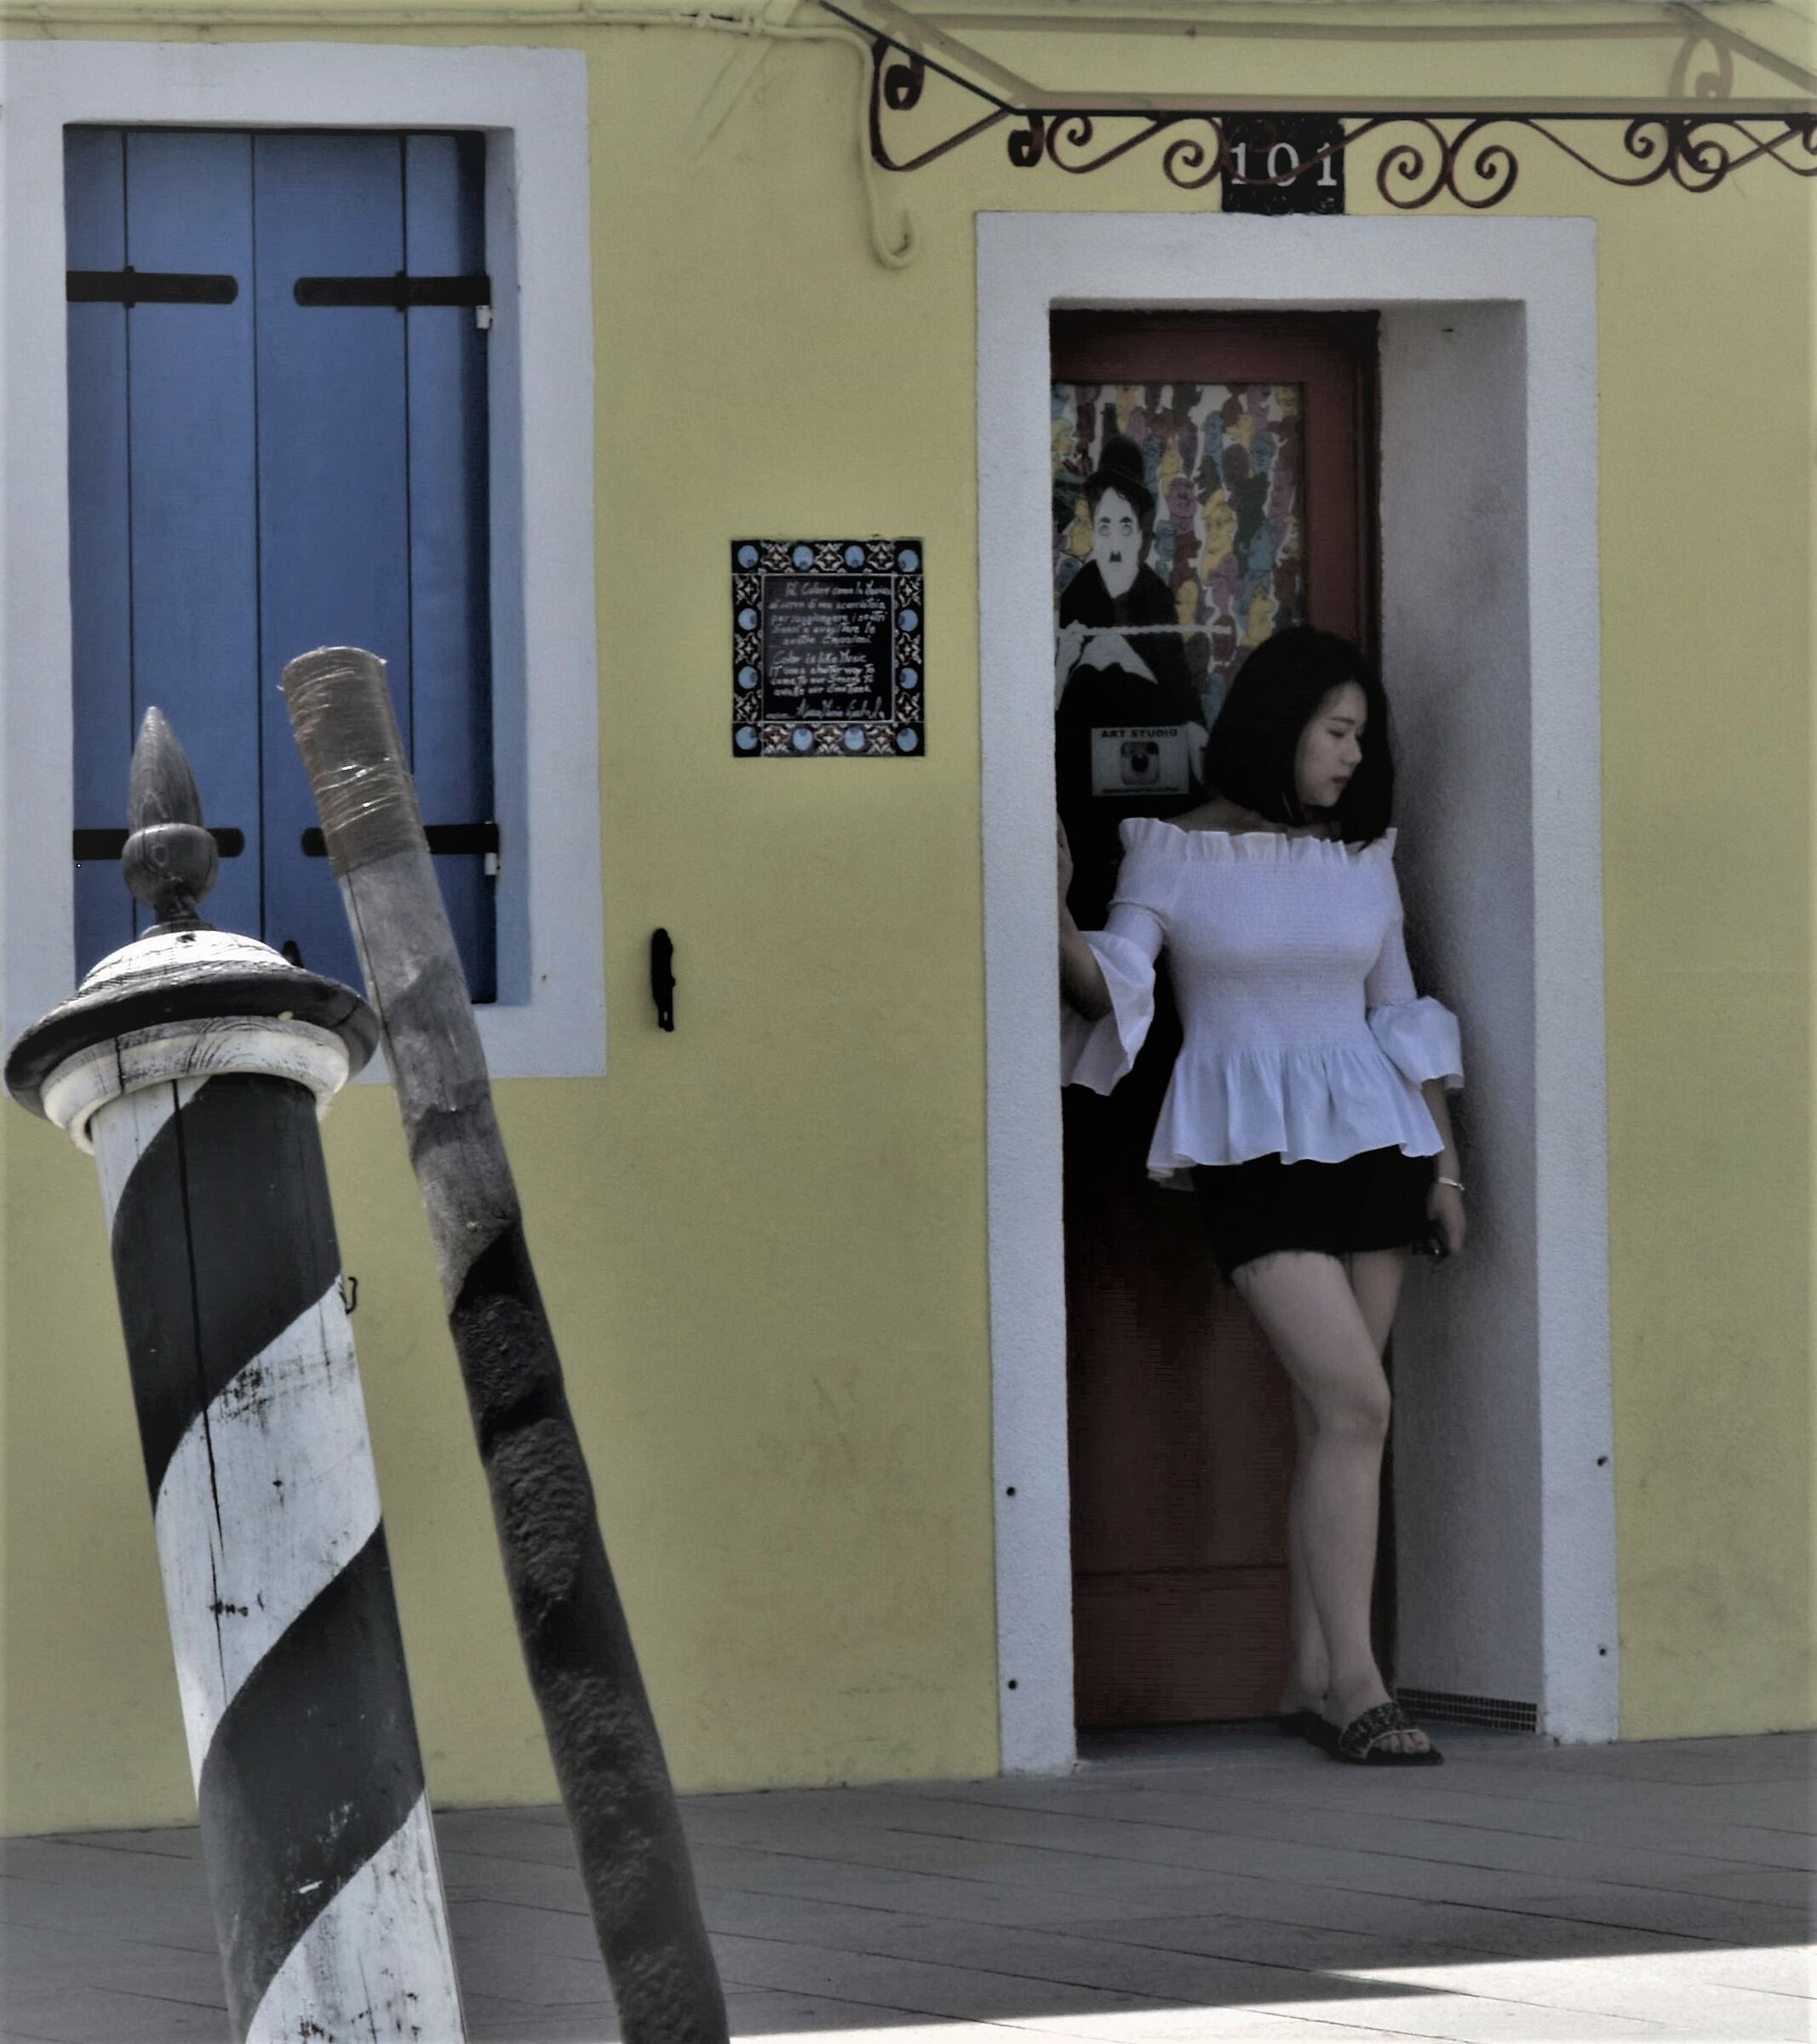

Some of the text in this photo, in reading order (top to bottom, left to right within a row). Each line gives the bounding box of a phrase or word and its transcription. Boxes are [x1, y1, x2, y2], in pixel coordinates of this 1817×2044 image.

[1230, 141, 1338, 187] 101
[1102, 729, 1178, 738] ART STUDIO
